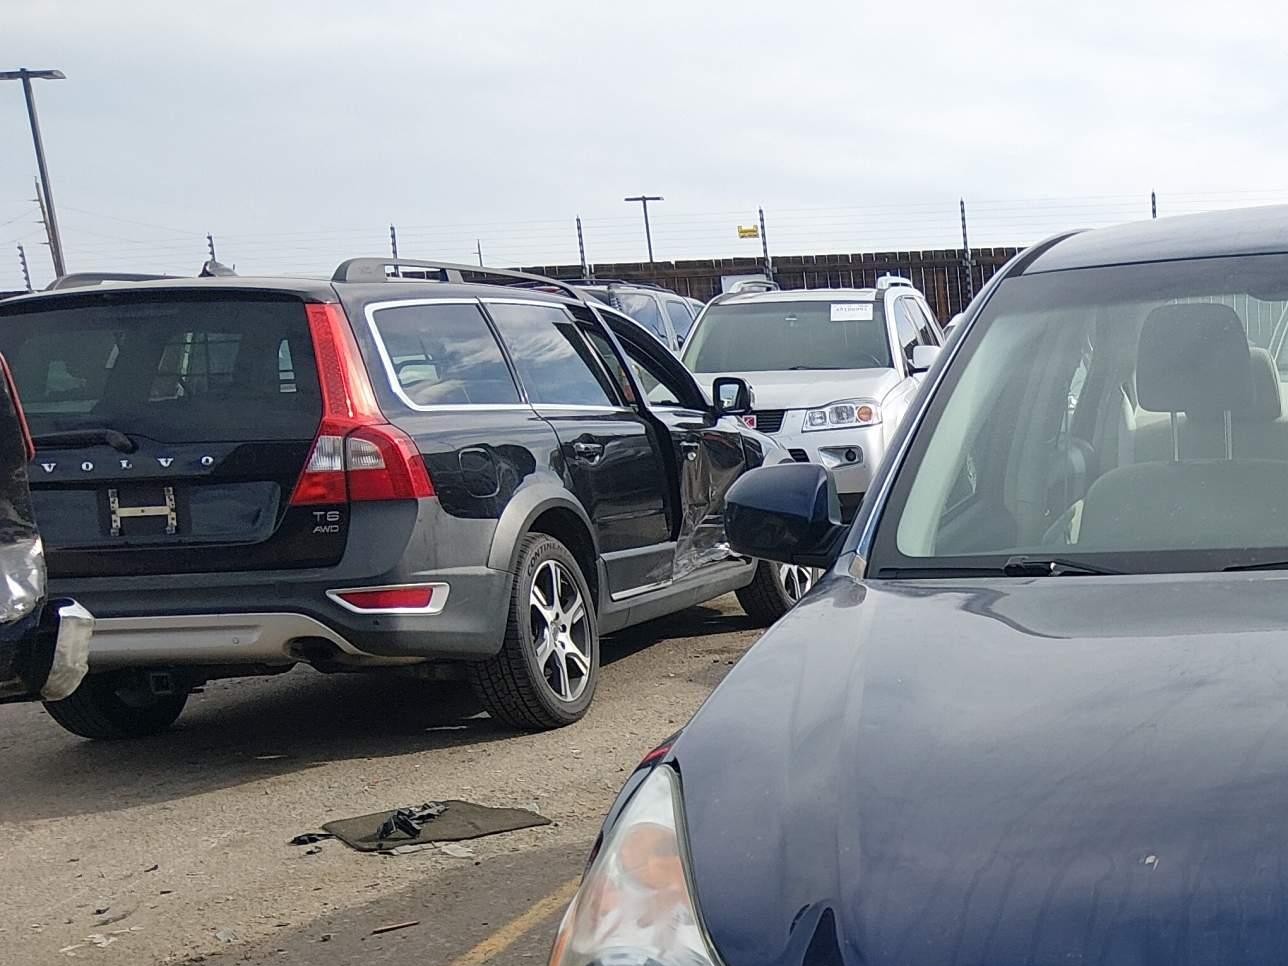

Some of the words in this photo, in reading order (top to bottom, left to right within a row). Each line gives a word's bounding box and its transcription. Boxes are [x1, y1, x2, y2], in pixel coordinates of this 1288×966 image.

[40, 455, 214, 473] VOLVO
[312, 510, 340, 522] T6
[312, 525, 339, 534] AWD
